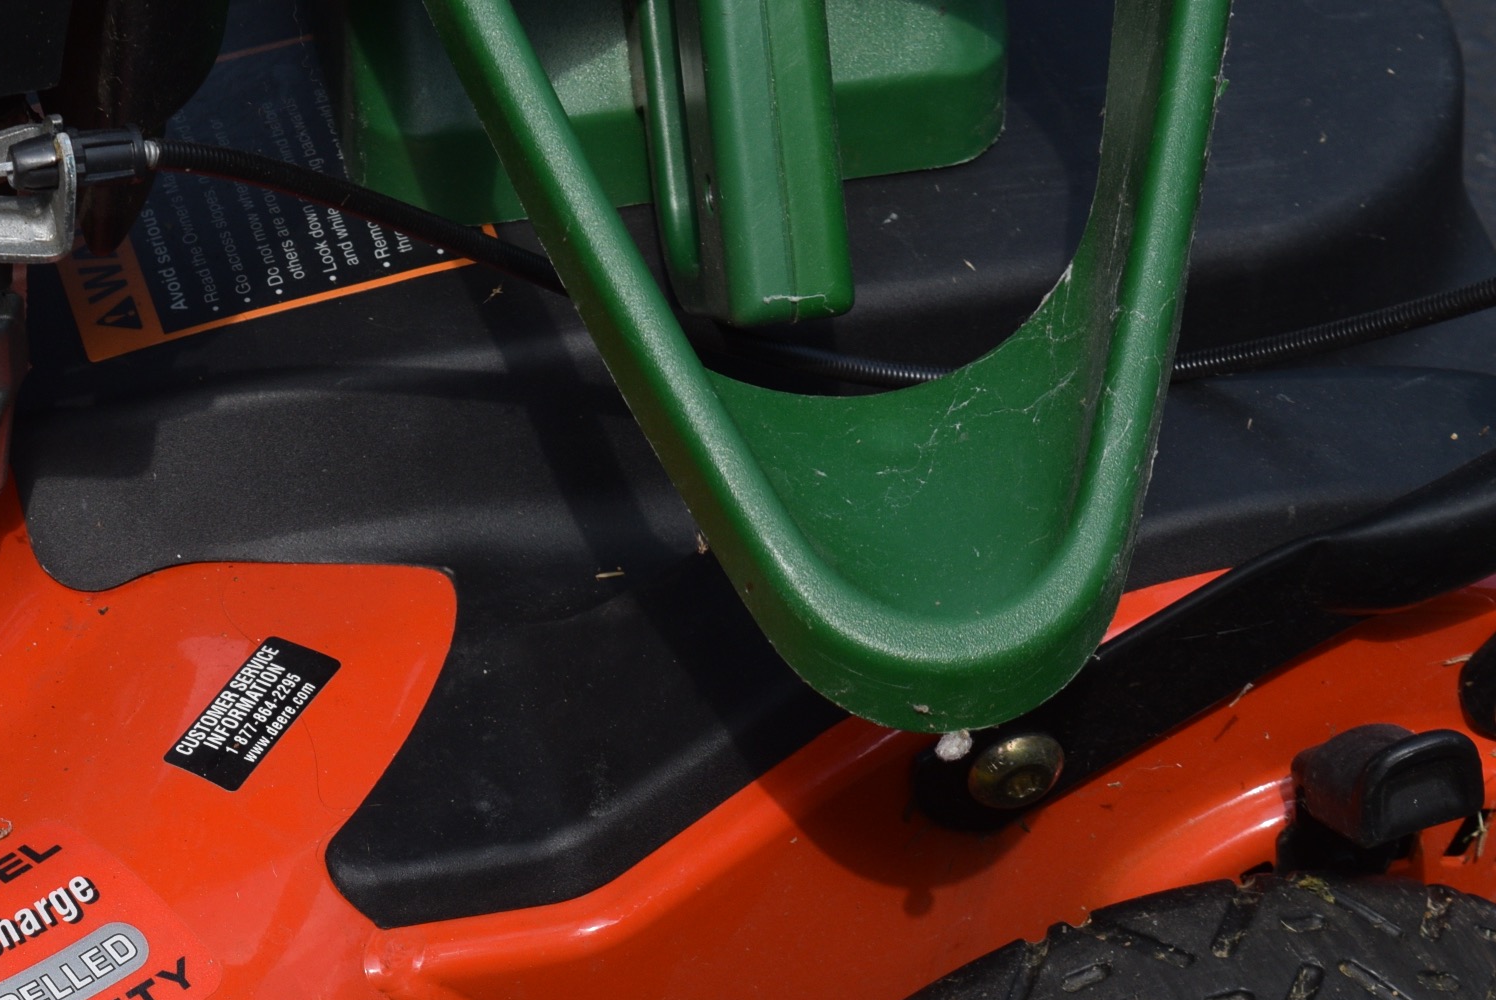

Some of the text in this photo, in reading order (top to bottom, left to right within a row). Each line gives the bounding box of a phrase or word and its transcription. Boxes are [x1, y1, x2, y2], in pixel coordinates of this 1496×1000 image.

[141, 208, 171, 265] serious
[252, 215, 268, 242] mow
[262, 186, 306, 280] others are arou
[302, 204, 325, 239] down
[328, 206, 349, 238] while
[366, 218, 391, 259] Remo
[174, 195, 220, 303] Read the Owner's
[221, 230, 243, 271] across
[261, 243, 276, 265] not
[313, 239, 338, 273] Look
[337, 241, 360, 267] and
[159, 267, 188, 311] Avoid
[235, 273, 252, 296] Go
[266, 266, 284, 287] Do
[175, 645, 280, 756] CUSTOMER SERVICE
[203, 663, 286, 750] INFORMATION
[244, 682, 316, 763] www.deere.com
